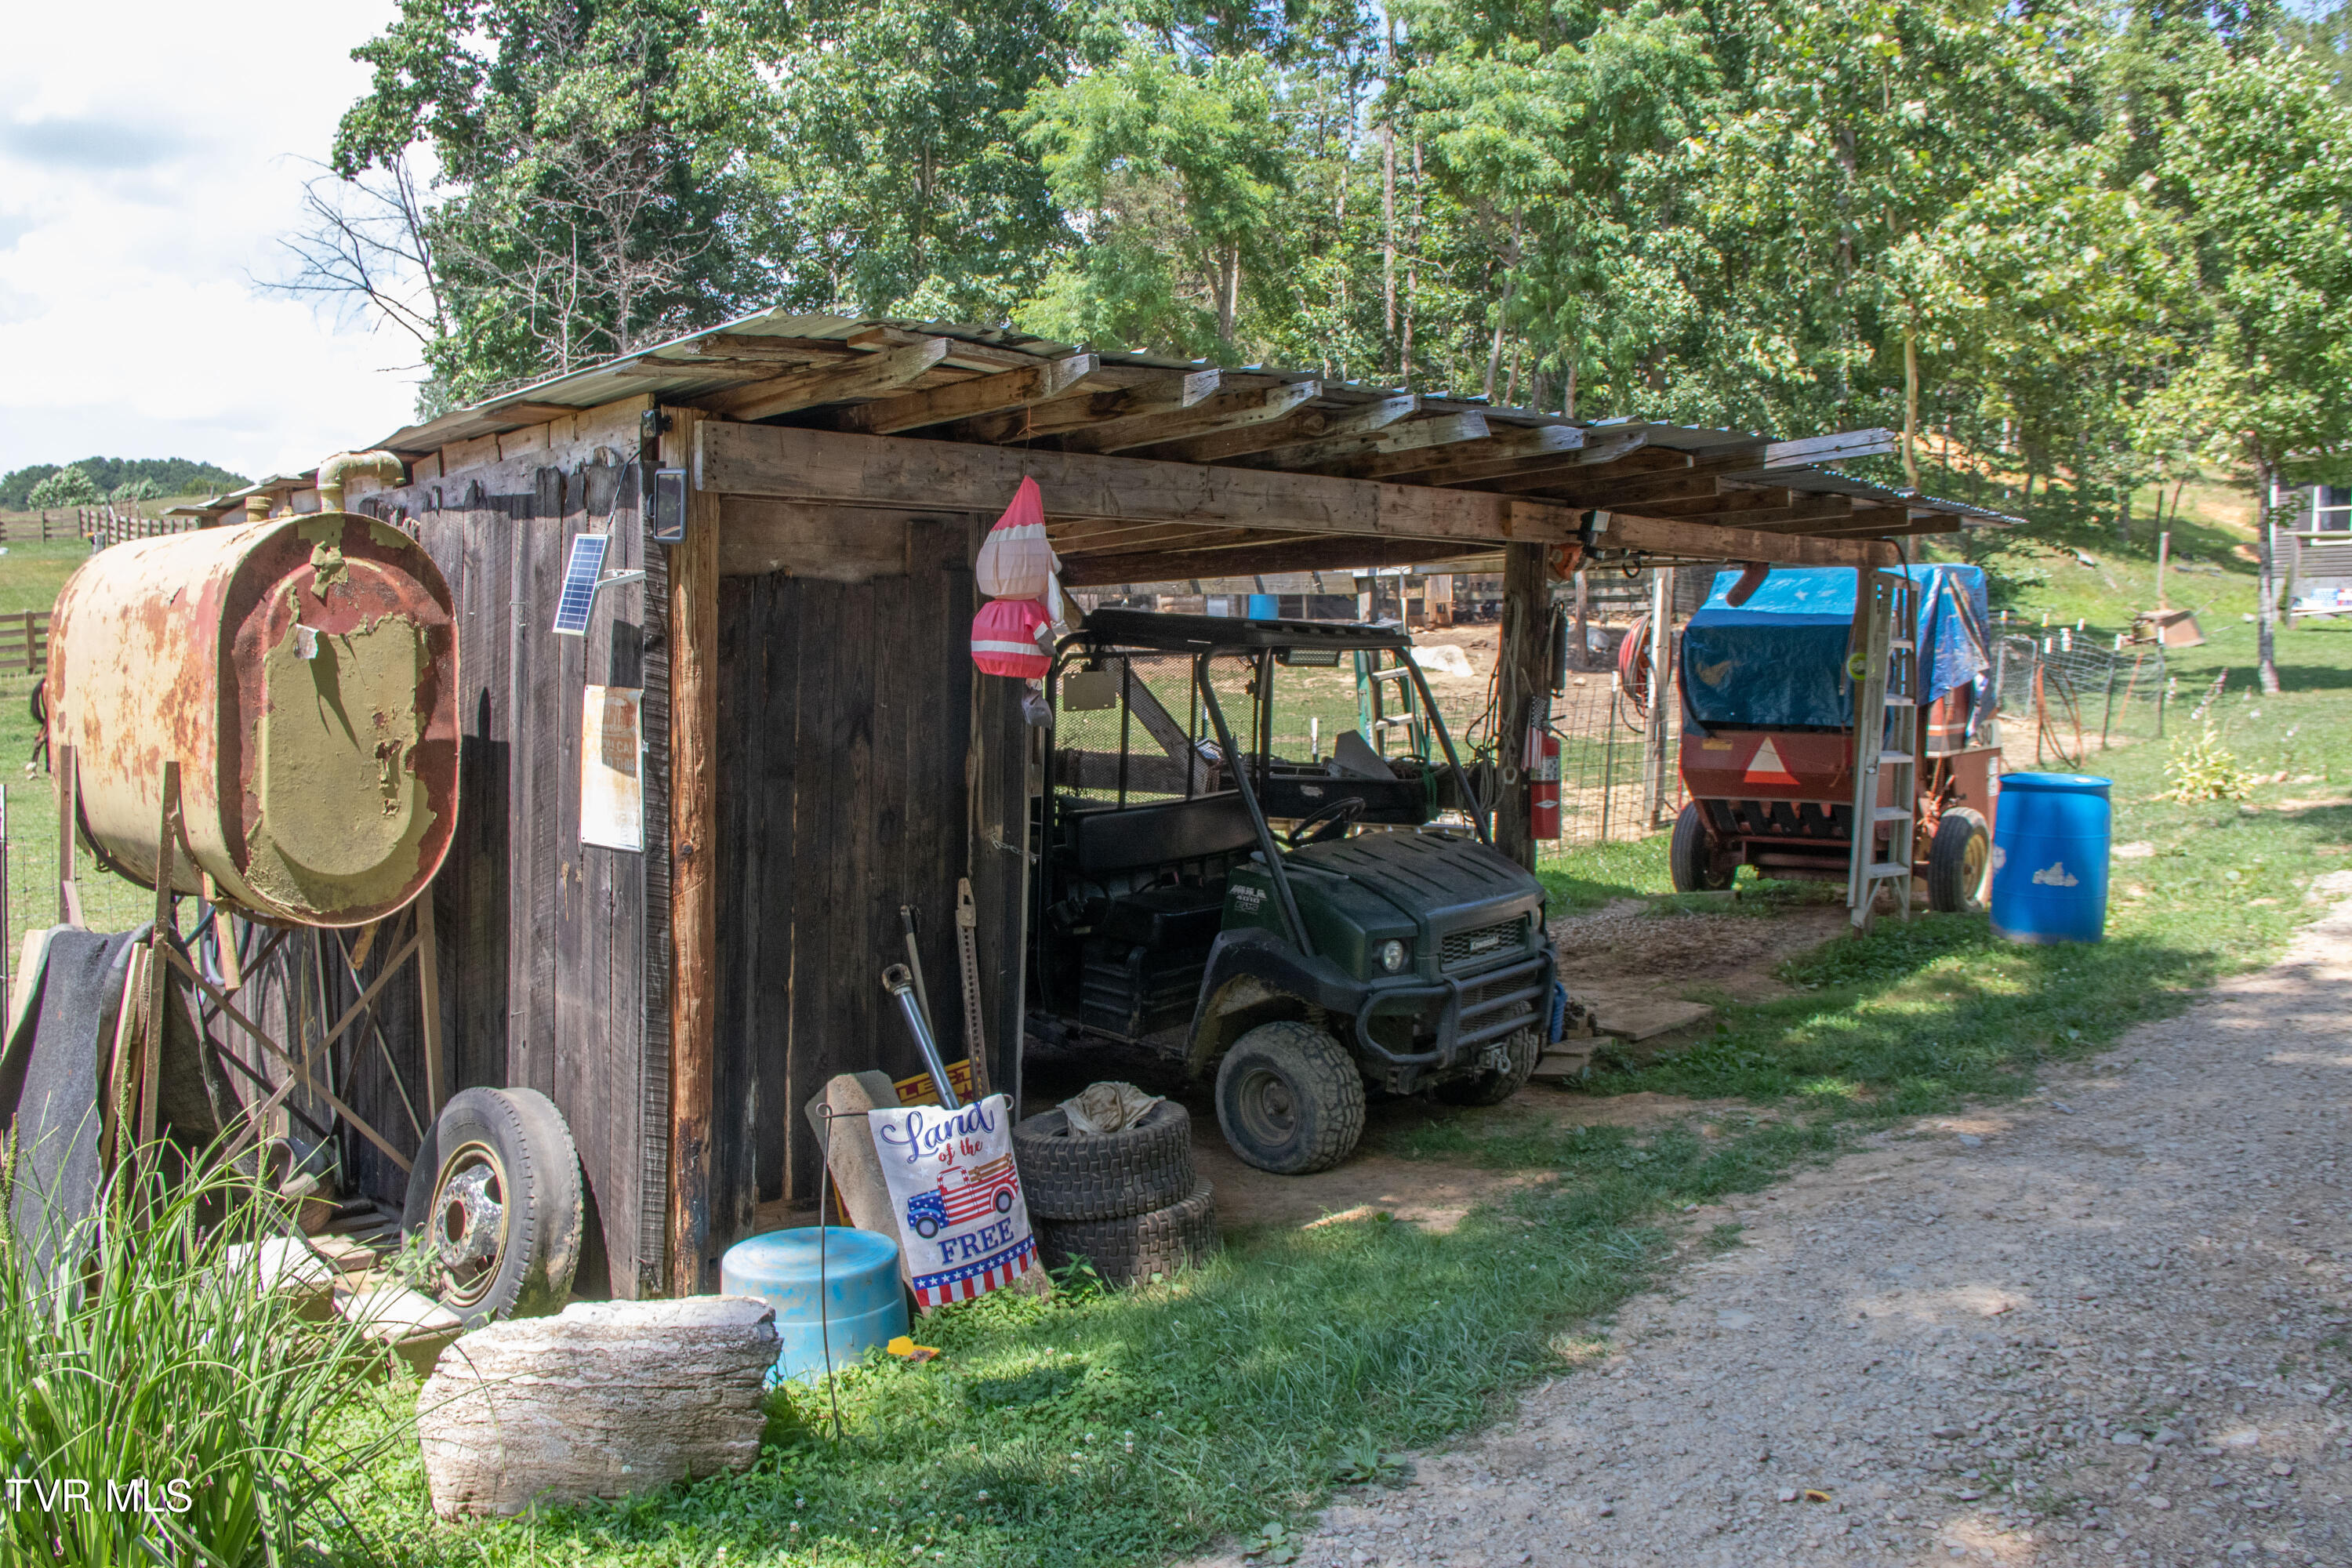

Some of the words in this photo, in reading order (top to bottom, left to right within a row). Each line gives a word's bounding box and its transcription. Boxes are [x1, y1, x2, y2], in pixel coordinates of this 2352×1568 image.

[1229, 884, 1268, 900] MULE
[880, 1100, 995, 1163] Land
[938, 1142, 956, 1166] of
[960, 1137, 983, 1157] the
[938, 1217, 1014, 1265] FREE
